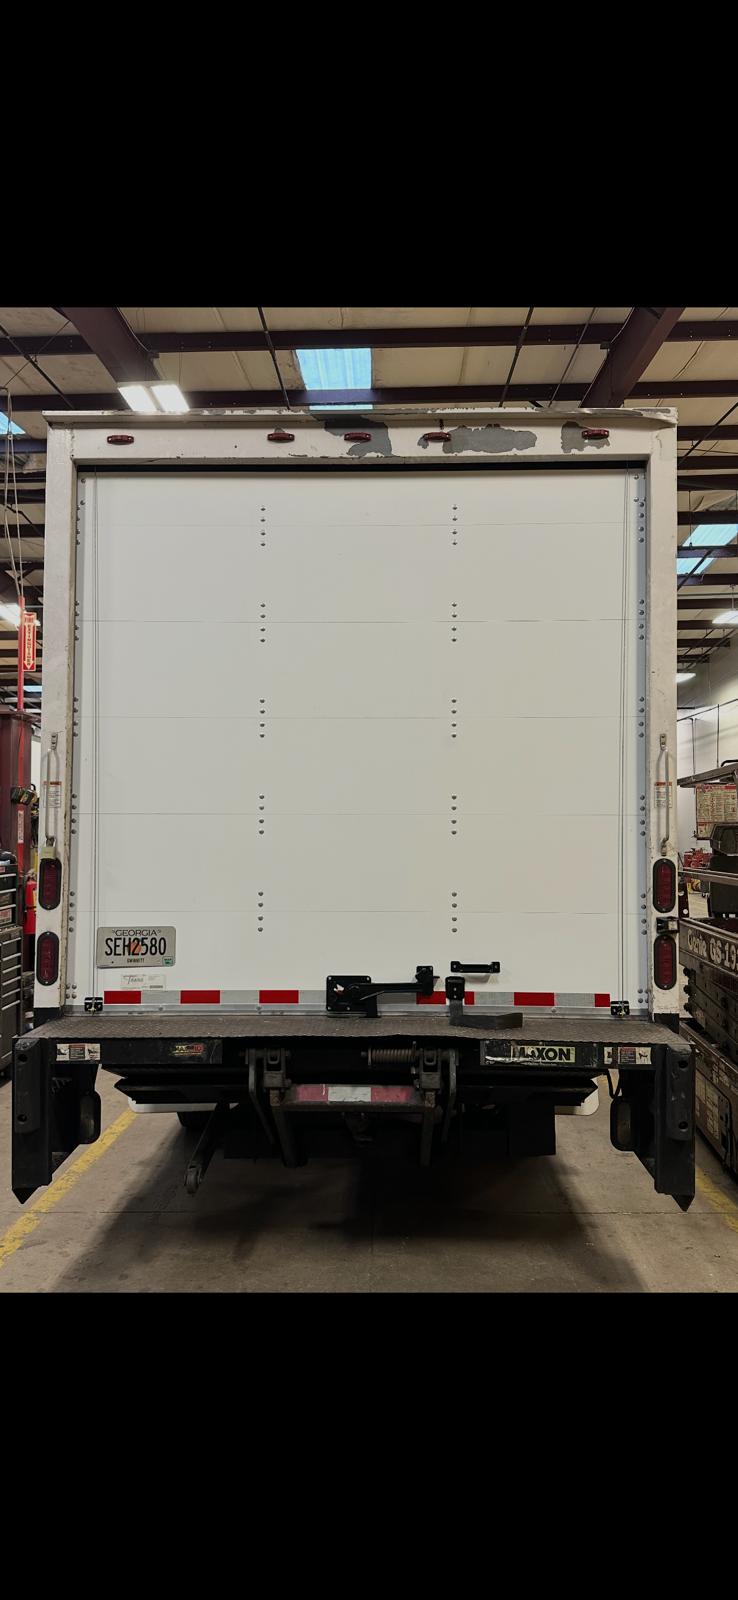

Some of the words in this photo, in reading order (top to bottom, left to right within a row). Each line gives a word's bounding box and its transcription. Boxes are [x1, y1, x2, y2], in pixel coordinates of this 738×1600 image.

[115, 929, 158, 937] GEORGIA
[687, 928, 708, 958] Genie
[104, 936, 167, 957] SEH2580
